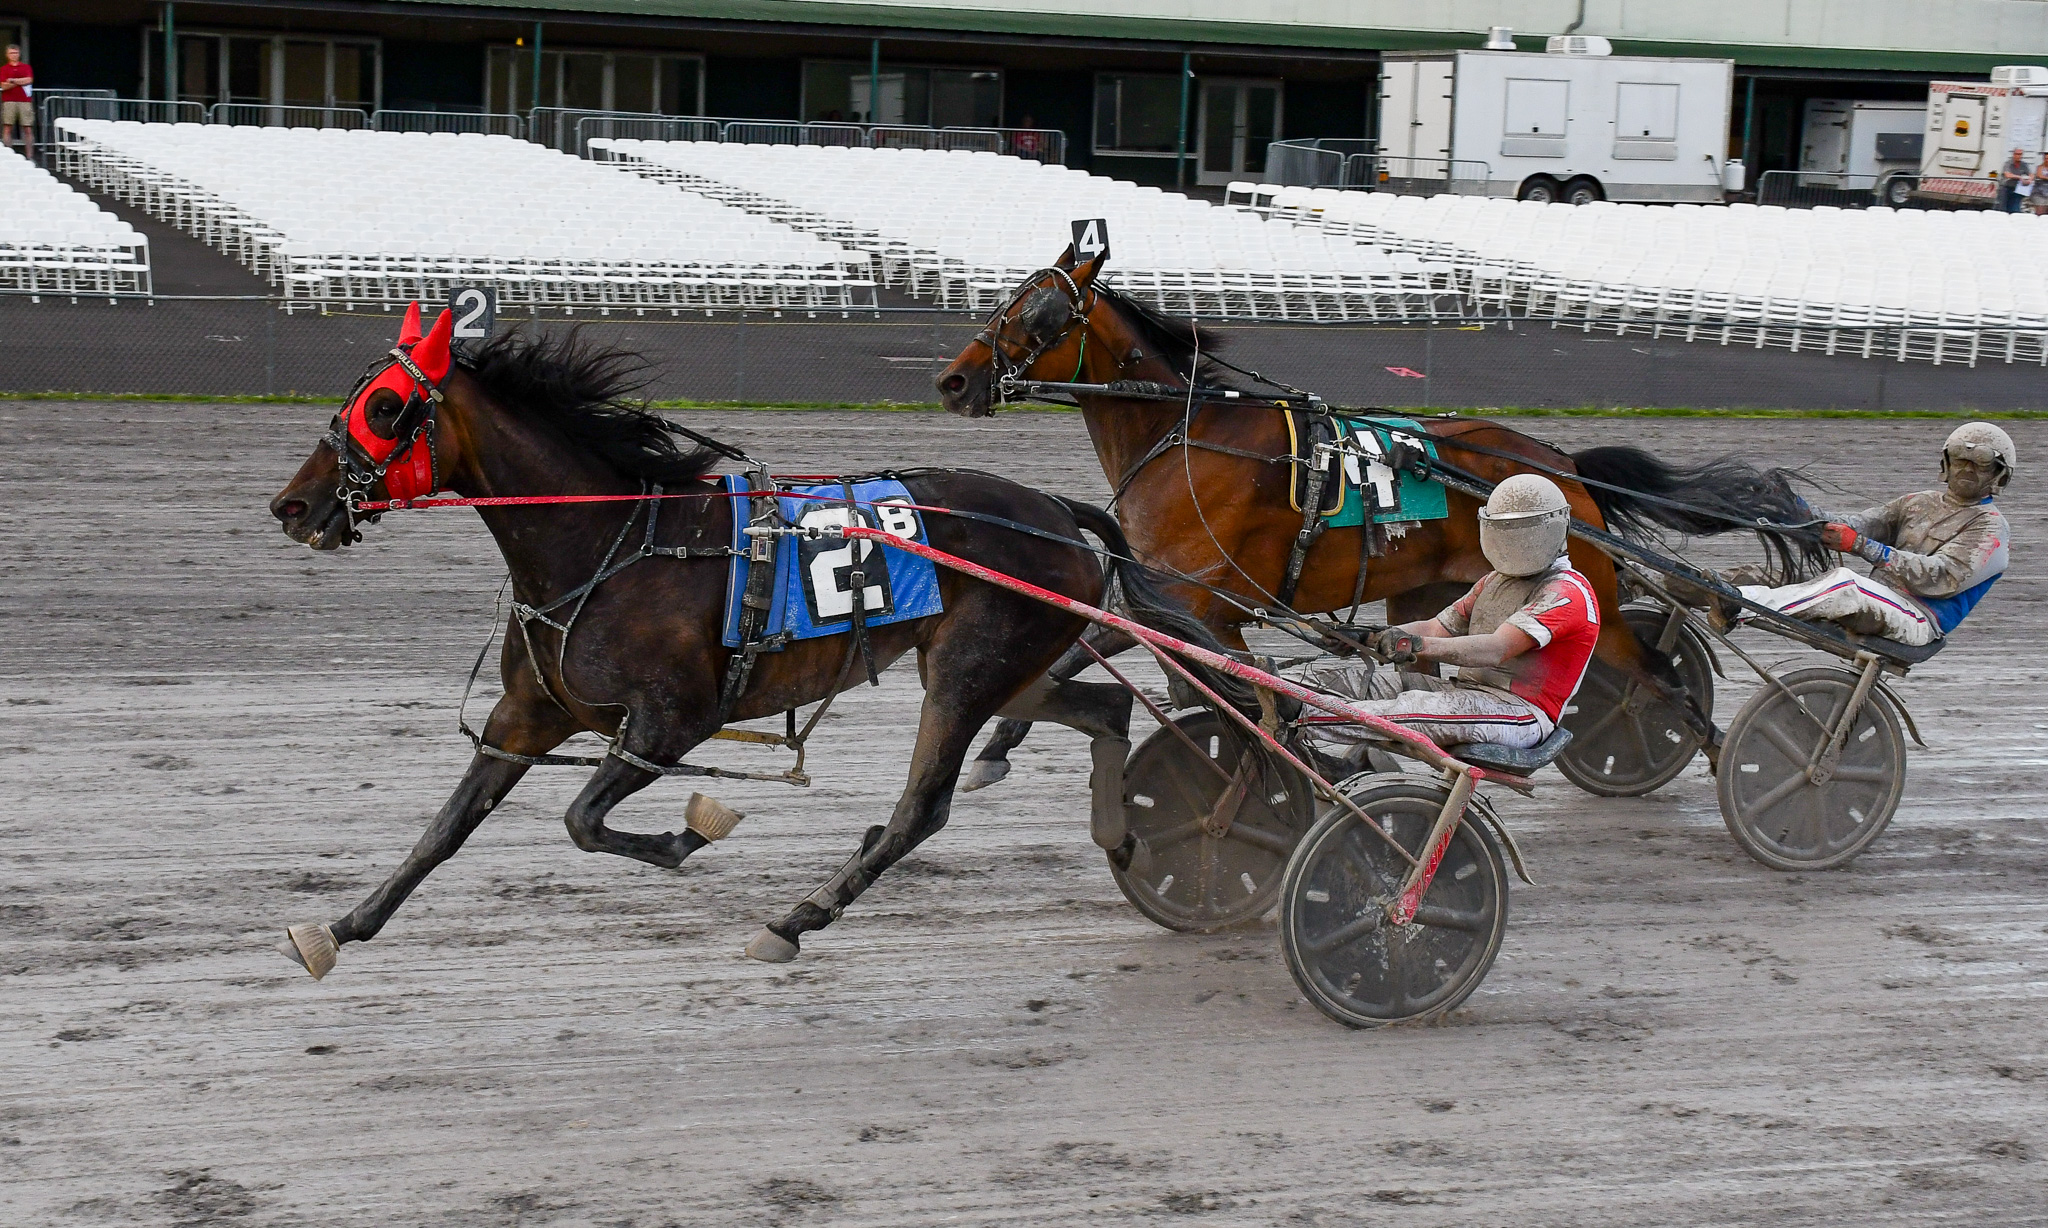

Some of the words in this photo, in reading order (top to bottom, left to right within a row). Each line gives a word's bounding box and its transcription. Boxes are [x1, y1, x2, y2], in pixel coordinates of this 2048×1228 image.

[1079, 220, 1105, 258] 4
[454, 289, 487, 337] 2
[877, 499, 918, 540] 8
[801, 507, 885, 618] 2
